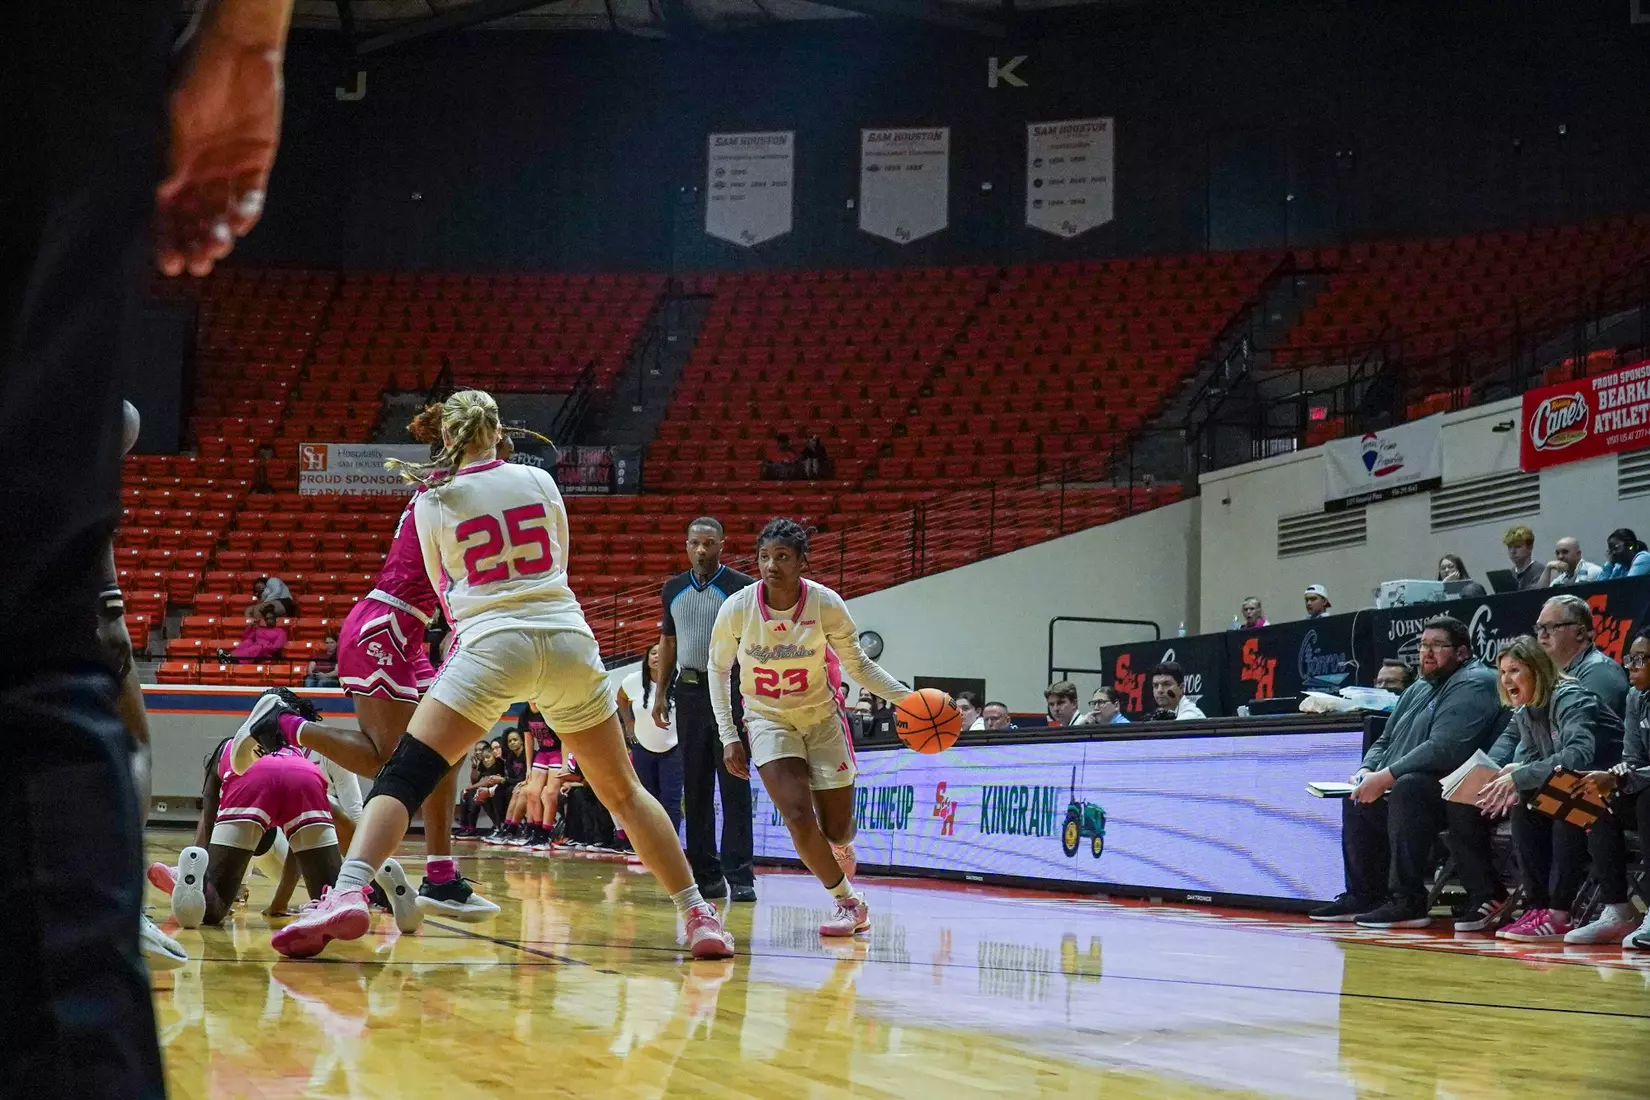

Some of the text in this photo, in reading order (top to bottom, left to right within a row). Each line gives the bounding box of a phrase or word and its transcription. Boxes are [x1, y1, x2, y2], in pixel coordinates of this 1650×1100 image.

[336, 71, 367, 101] J
[988, 55, 1028, 87] K
[714, 135, 788, 146] SAM HOUSTON
[867, 131, 942, 142] SAM HOUSTON
[1034, 122, 1107, 136] SAM HOUSTON
[1592, 373, 1618, 391] PROUD
[1533, 392, 1588, 449] Cane's
[1594, 403, 1650, 435] ATHLET
[337, 449, 384, 459] Hospitality
[1620, 434, 1628, 443] US
[300, 475, 403, 484] PROUD SPONSOR
[361, 488, 416, 496] ATHLETIC
[455, 503, 553, 587] 25
[753, 667, 809, 699] 23
[1114, 652, 1146, 712] SH
[1241, 637, 1277, 700] SH
[870, 785, 914, 830] LINEUP
[932, 781, 958, 836] SH
[980, 785, 1057, 837] KINGRAN
